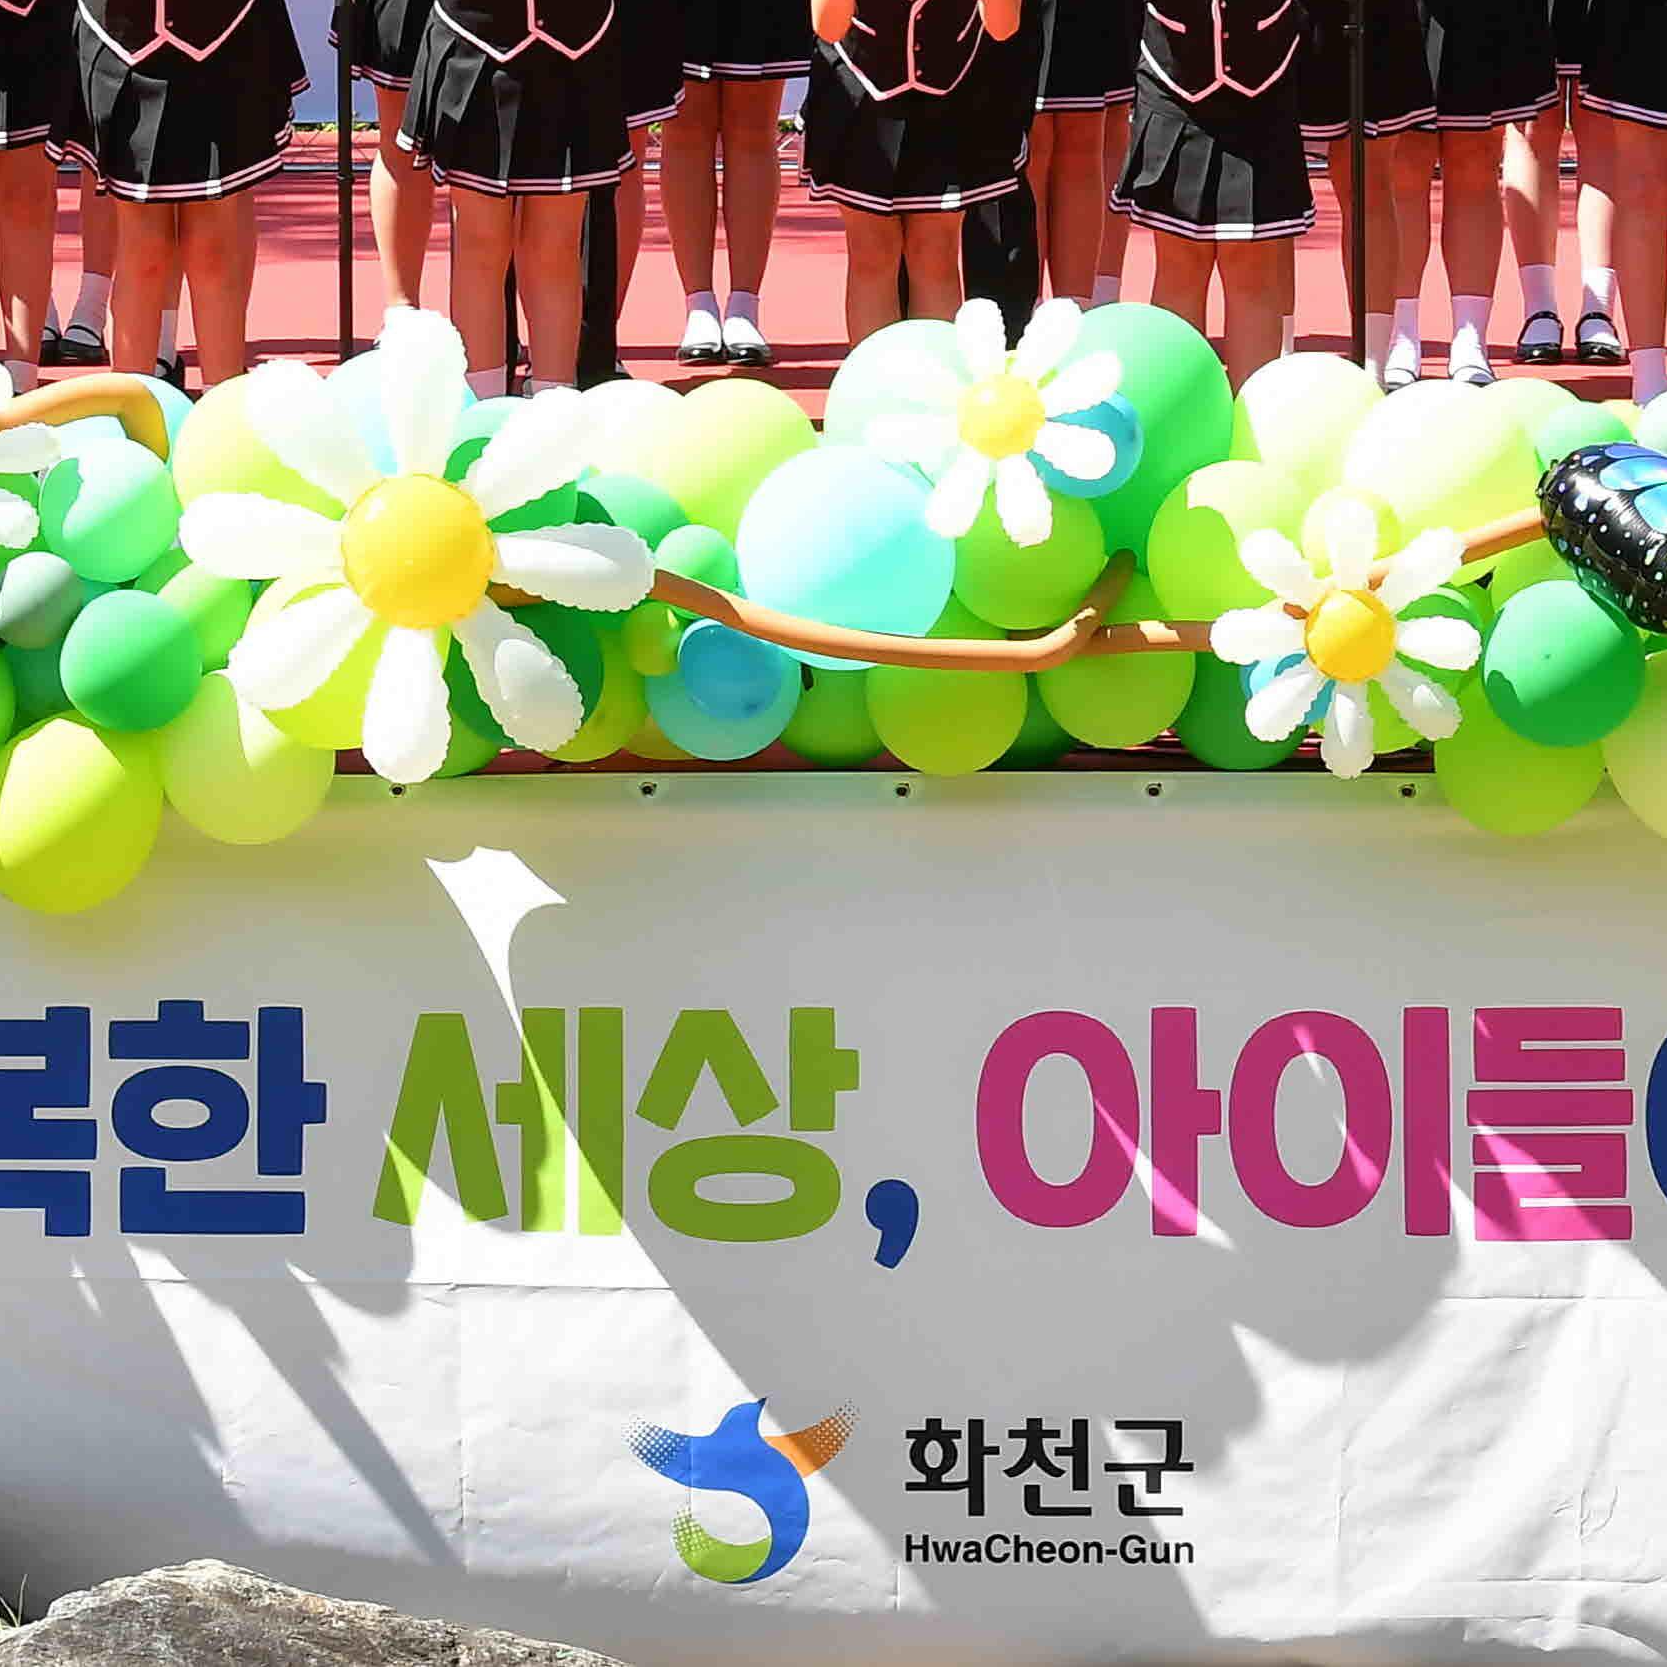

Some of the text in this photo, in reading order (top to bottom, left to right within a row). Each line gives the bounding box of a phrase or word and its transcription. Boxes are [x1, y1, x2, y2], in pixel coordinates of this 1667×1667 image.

[372, 1007, 920, 1269] 세상,
[904, 1417, 1195, 1517] 화천군
[904, 1533, 1195, 1566] HwaCheon-Gun
